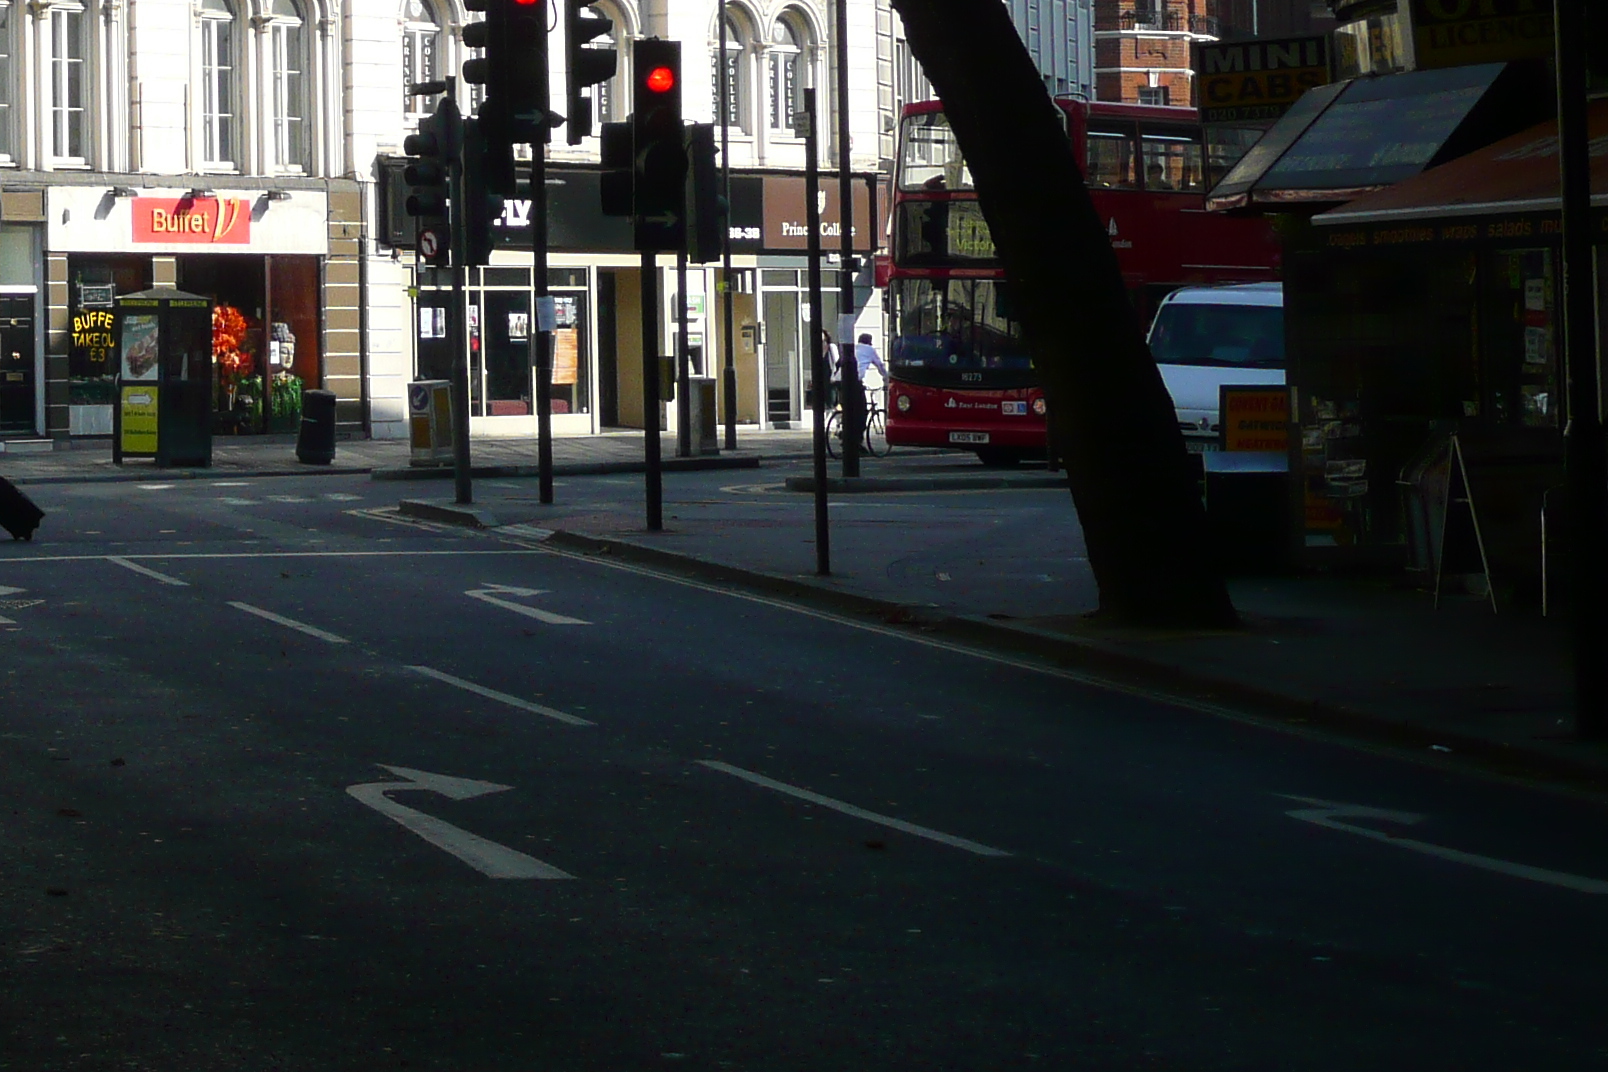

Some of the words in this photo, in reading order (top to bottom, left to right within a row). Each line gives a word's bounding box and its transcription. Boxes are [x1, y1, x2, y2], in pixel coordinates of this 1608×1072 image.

[1429, 15, 1554, 48] LICENCE
[424, 37, 433, 105] COLLEE
[1205, 39, 1318, 73] MINI
[728, 57, 736, 123] COLLEGE
[786, 61, 794, 125] COLLEGE
[1209, 107, 1237, 120] 020
[1488, 218, 1532, 237] salads
[73, 311, 114, 332] BUFFE
[72, 332, 115, 348] TAKEOU
